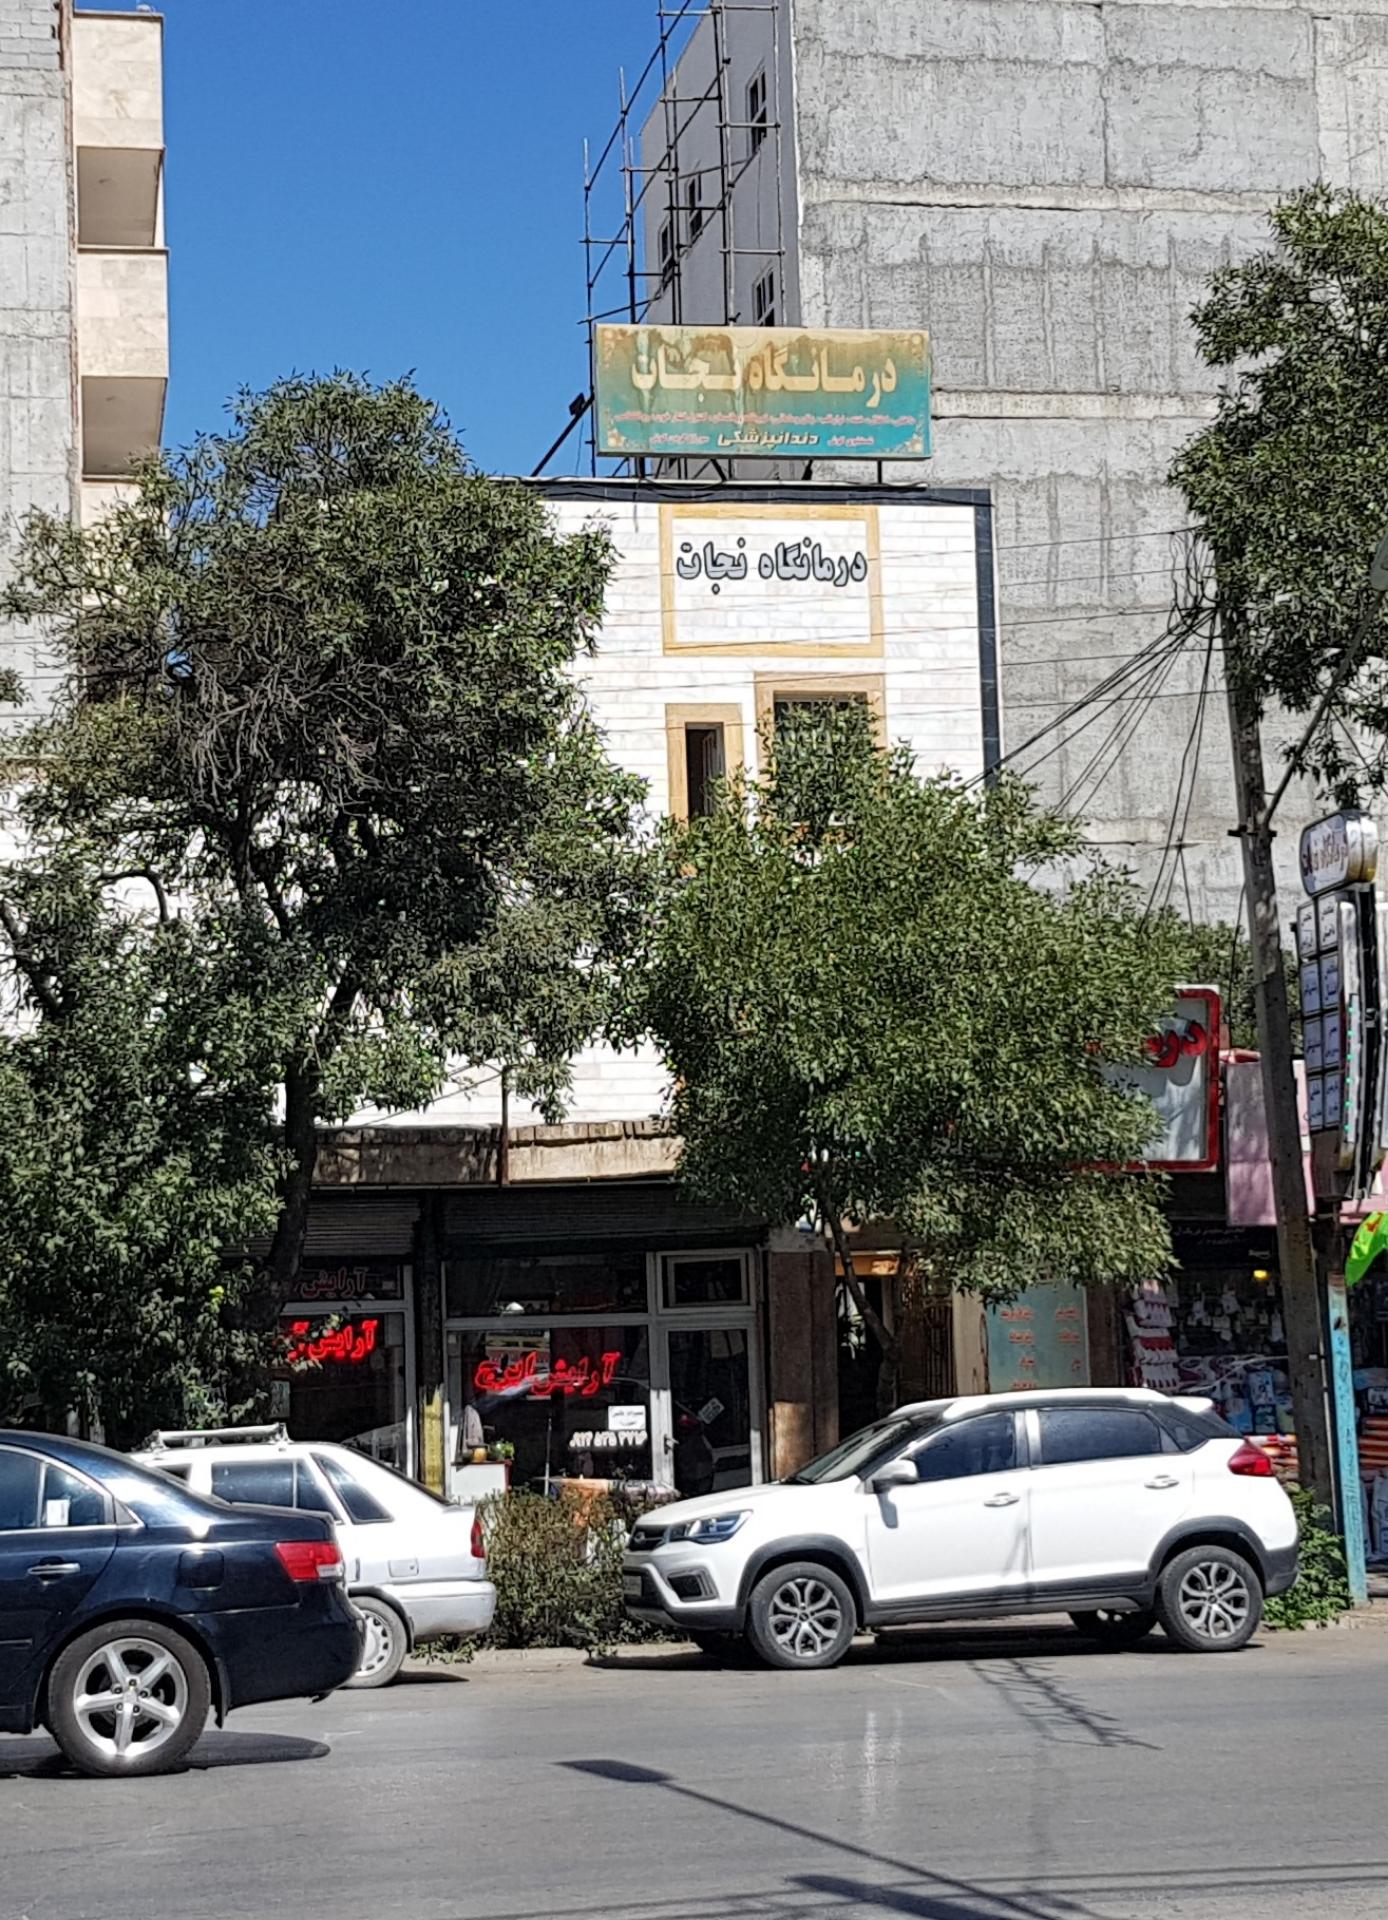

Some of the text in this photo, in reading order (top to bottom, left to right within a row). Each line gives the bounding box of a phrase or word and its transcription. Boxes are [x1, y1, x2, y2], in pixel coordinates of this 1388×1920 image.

[748, 341, 897, 408] درمانگاه
[676, 536, 868, 595] درمانگاه نجات
[532, 1352, 621, 1396] آرایش
